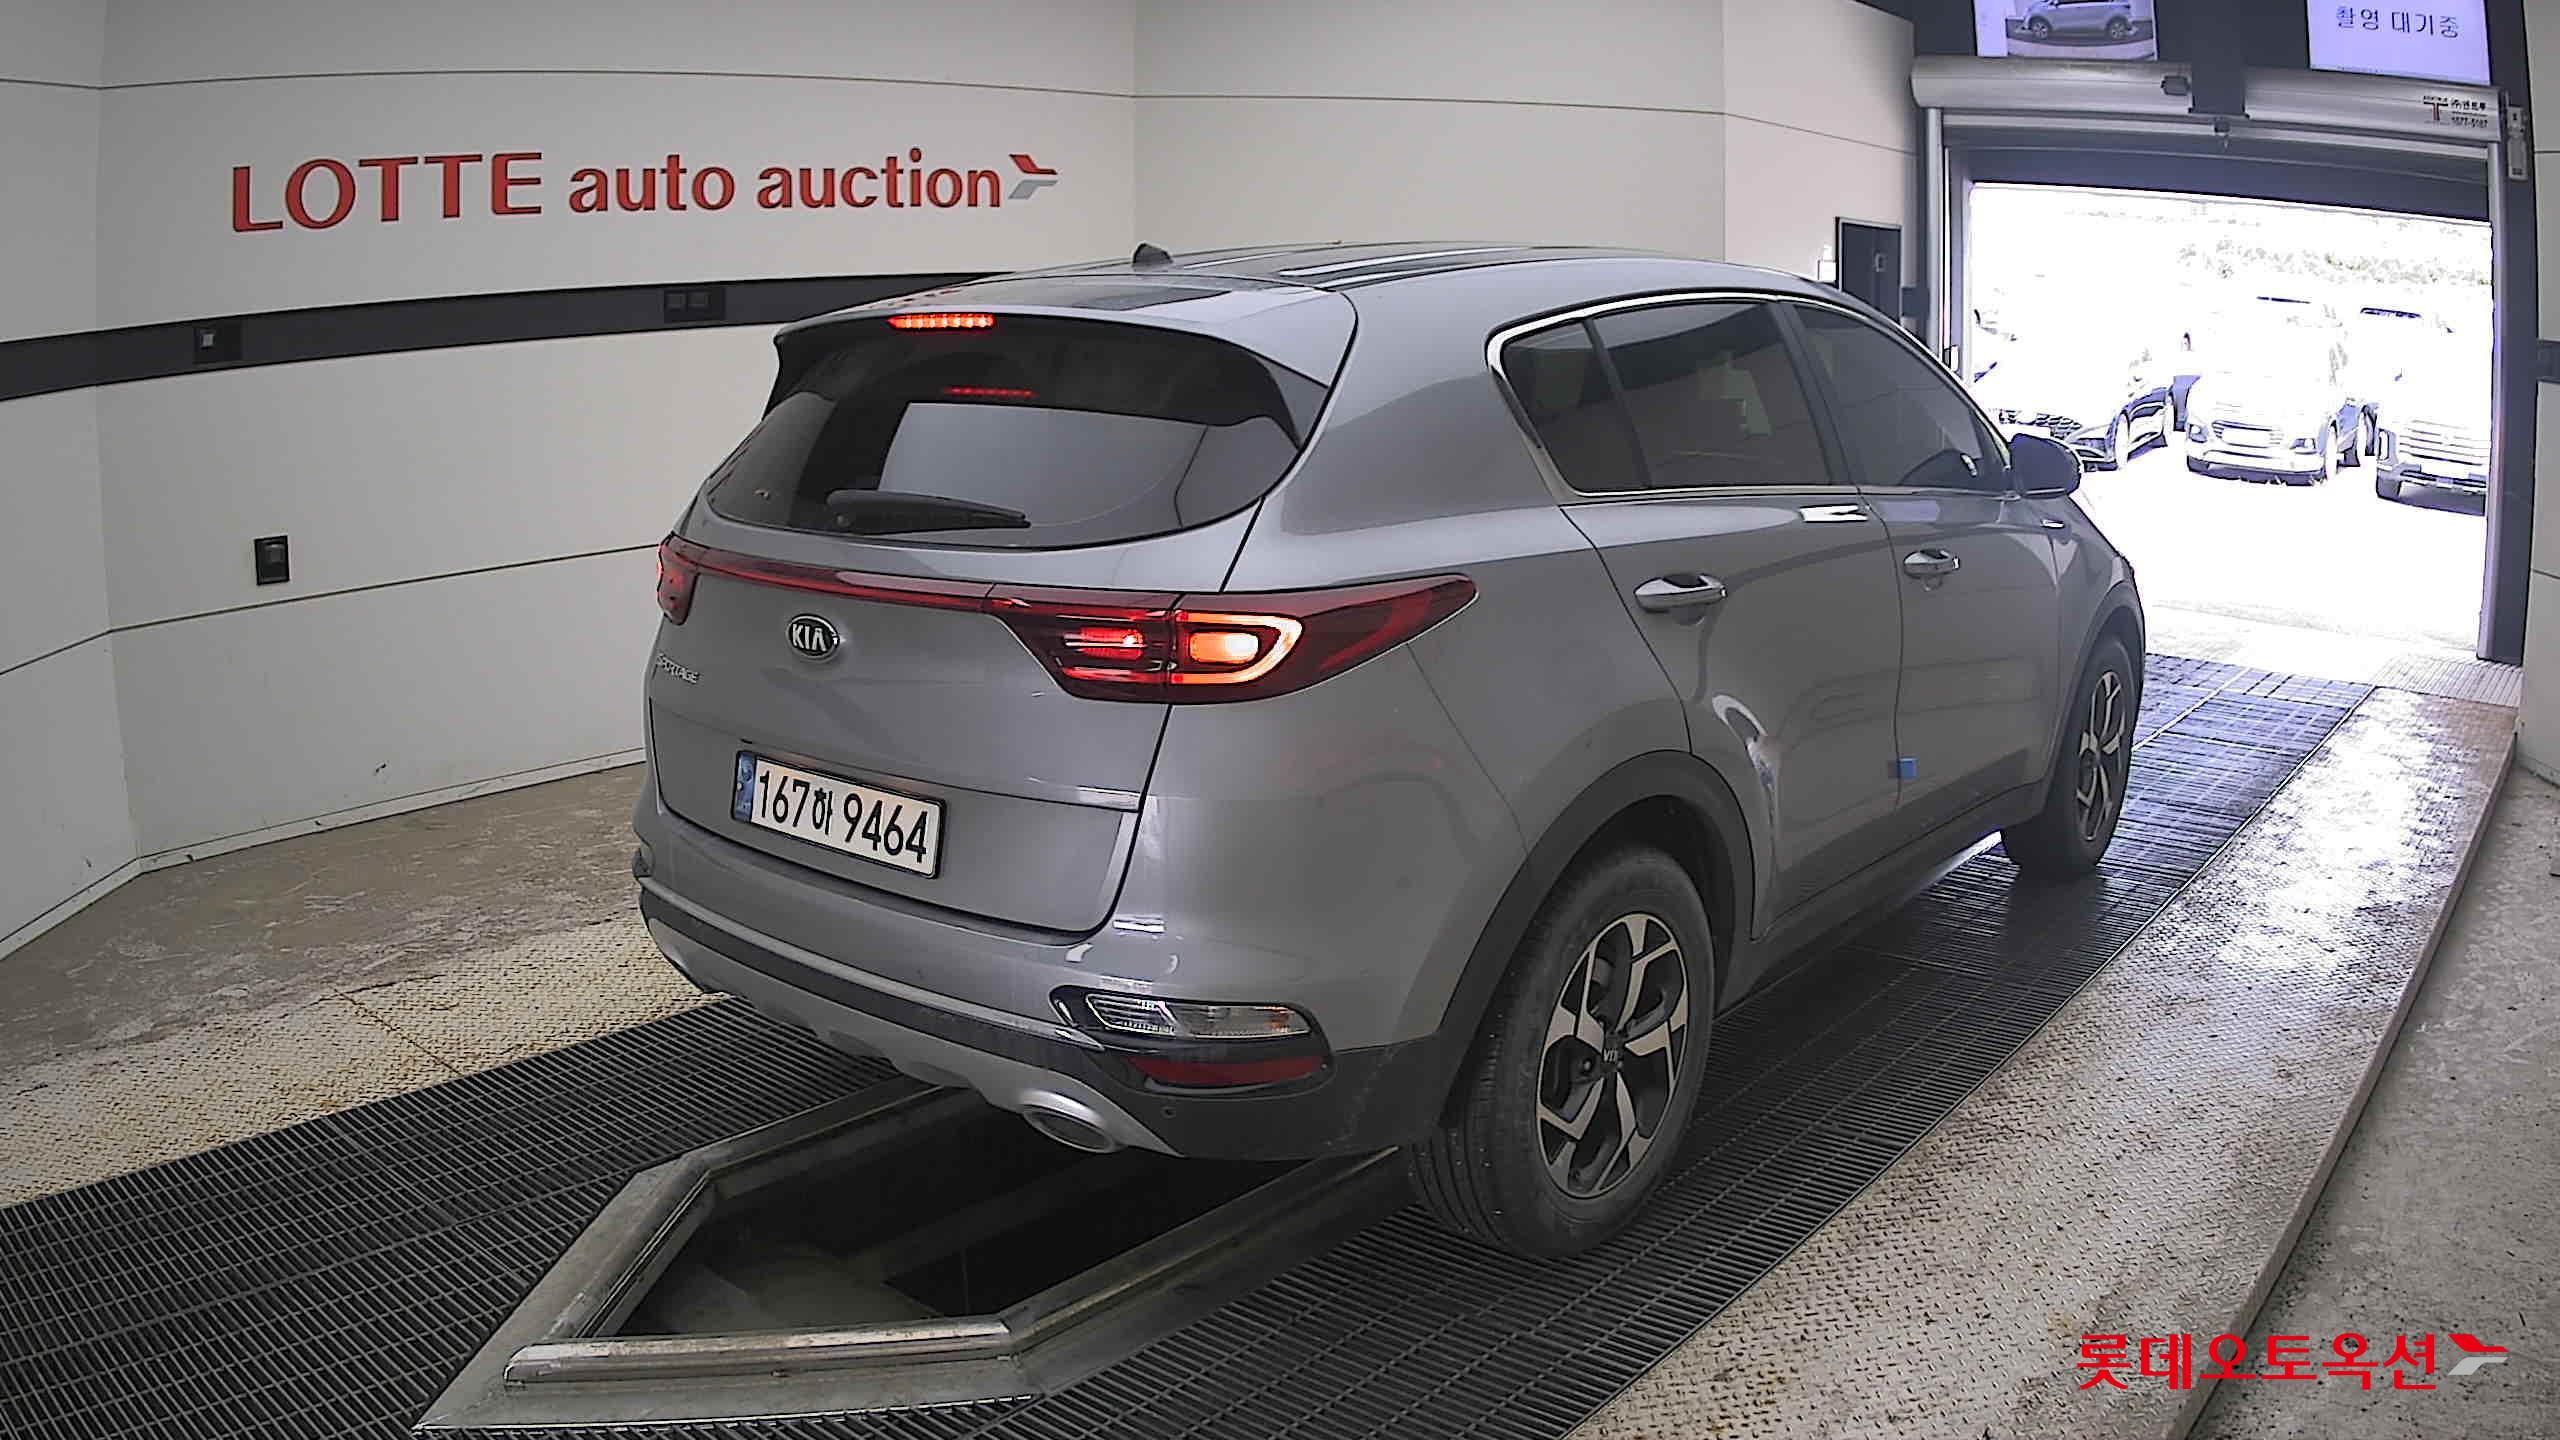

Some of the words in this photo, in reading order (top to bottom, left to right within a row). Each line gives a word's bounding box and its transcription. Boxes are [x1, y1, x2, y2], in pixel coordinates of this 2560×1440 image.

[2336, 5, 2379, 31] 촬영
[2391, 11, 2459, 39] 대기중
[233, 151, 542, 233] LOTTE
[569, 153, 735, 213] auto
[757, 147, 1002, 210] auction
[792, 623, 827, 652] KIA
[759, 769, 833, 836] 167하
[843, 792, 928, 864] 9464
